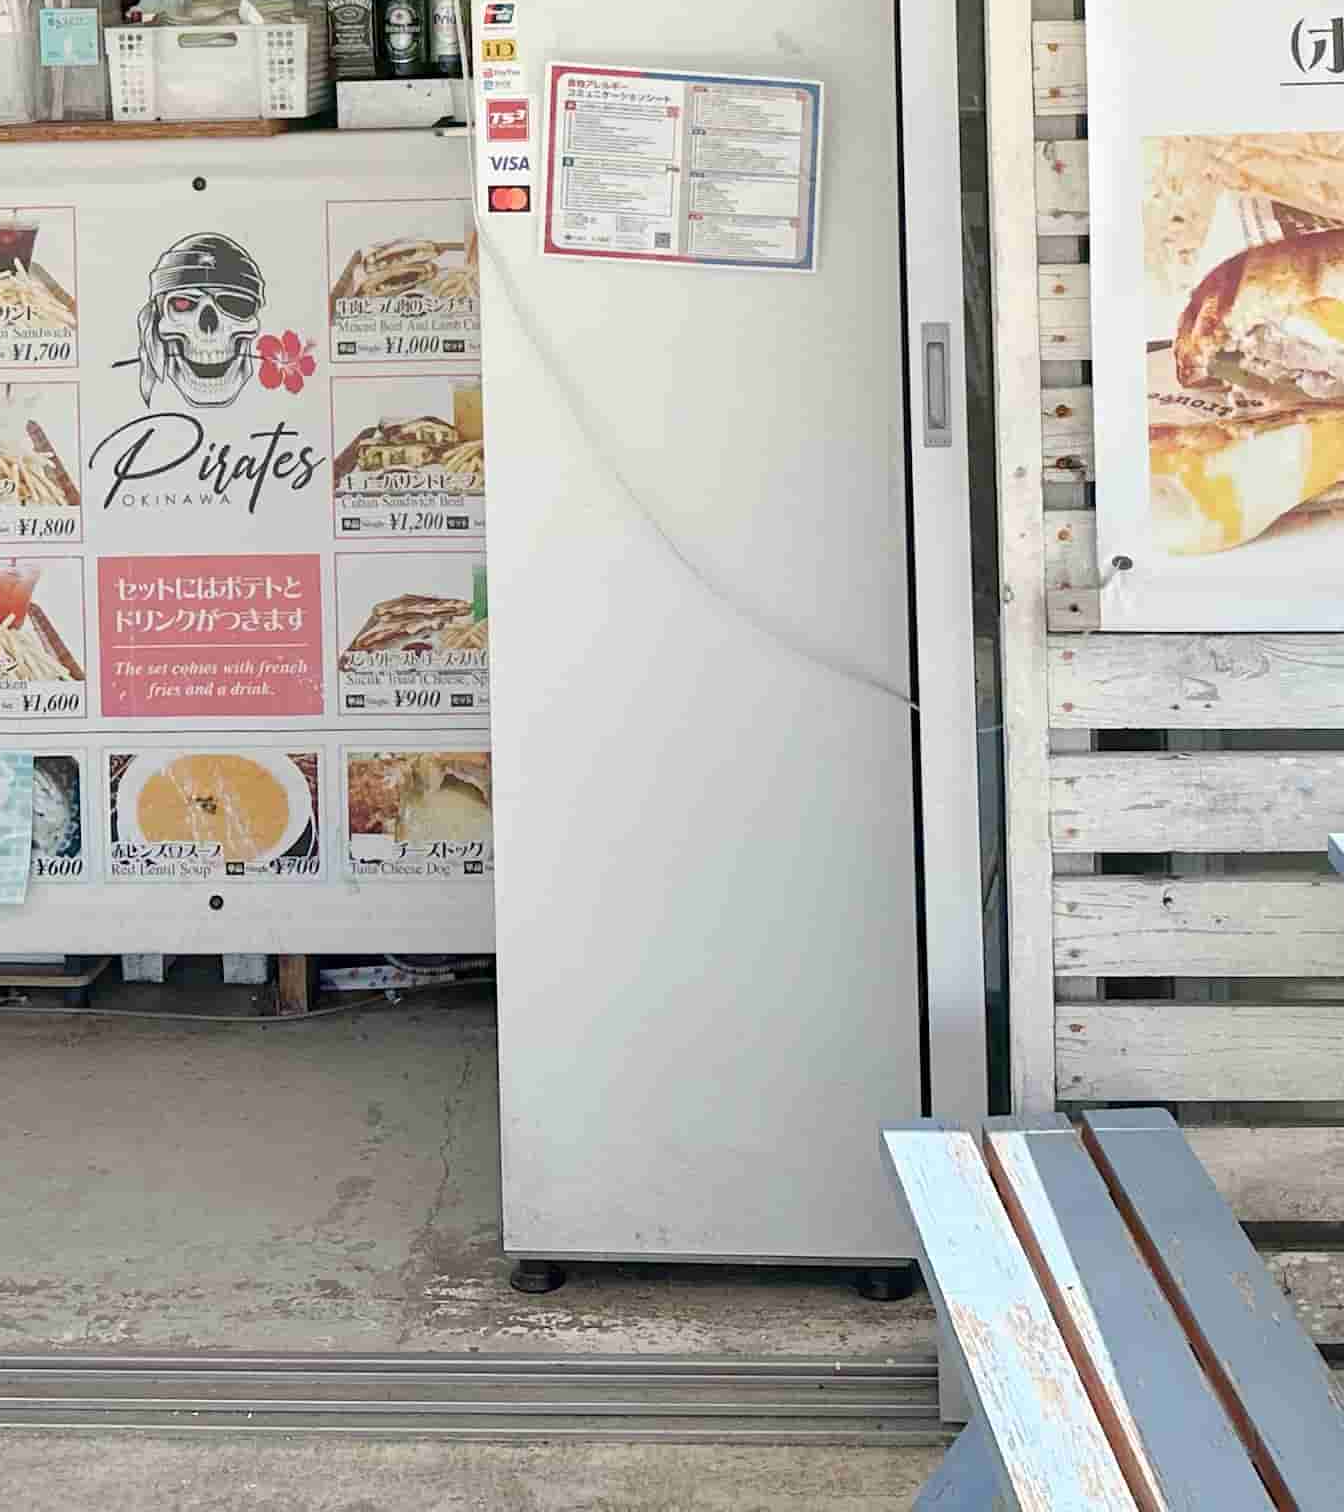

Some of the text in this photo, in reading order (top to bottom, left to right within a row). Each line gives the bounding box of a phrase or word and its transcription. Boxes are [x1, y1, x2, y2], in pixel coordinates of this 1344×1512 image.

[489, 156, 531, 171] VISA
[13, 343, 71, 362] ¥1,700
[386, 336, 440, 355] ¥1,000
[88, 413, 327, 514] Pirates
[122, 494, 232, 505] OKINAWA
[17, 519, 75, 537] ¥1,800
[391, 513, 444, 532] ¥1,200
[114, 576, 303, 601] セットにはポテトと
[116, 609, 308, 633] ドリンクがつきます
[114, 662, 142, 676] The
[223, 661, 256, 674] with
[146, 683, 181, 700] fries
[185, 682, 214, 696] and
[394, 689, 441, 707] ¥900
[24, 695, 79, 712] ¥1,600
[36, 858, 83, 876] ¥600
